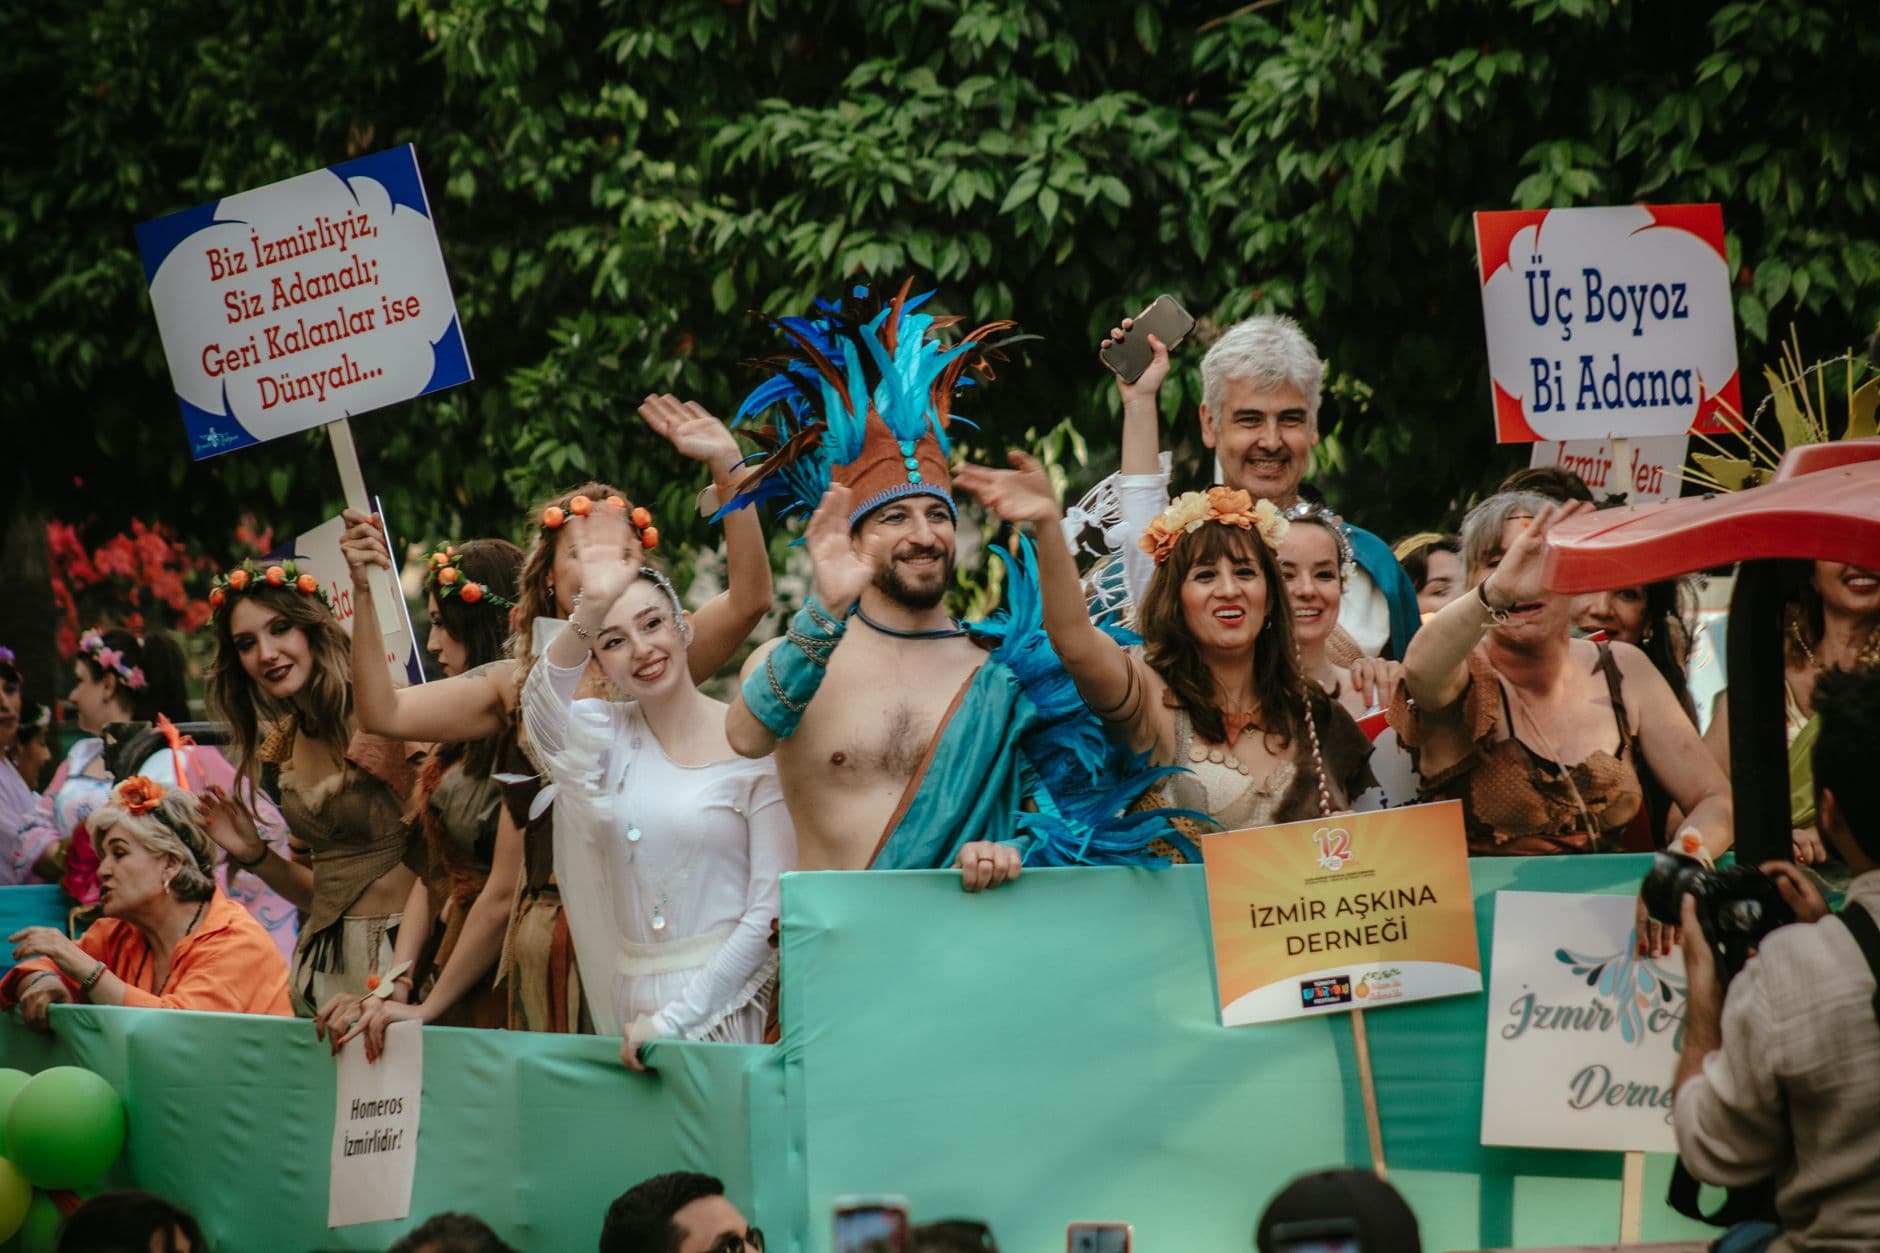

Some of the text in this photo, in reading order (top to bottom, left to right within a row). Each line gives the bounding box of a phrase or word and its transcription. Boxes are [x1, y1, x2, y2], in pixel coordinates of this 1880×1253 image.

[206, 210, 378, 281] Biz İzmirliyiz,
[224, 254, 379, 324] Siz Adanalı;
[1525, 255, 1689, 341] Üç Boyoz
[202, 295, 421, 378] Geri Kalanlar ise
[257, 354, 383, 410] Dünyalı...
[1530, 354, 1693, 413] Bi Adana
[1313, 827, 1353, 861] 12
[1250, 885, 1437, 928] İZMİR AŞKINA
[1287, 916, 1408, 956] DERNEĞİ
[351, 1096, 404, 1120] Homeros
[1568, 1064, 1676, 1125] Derne
